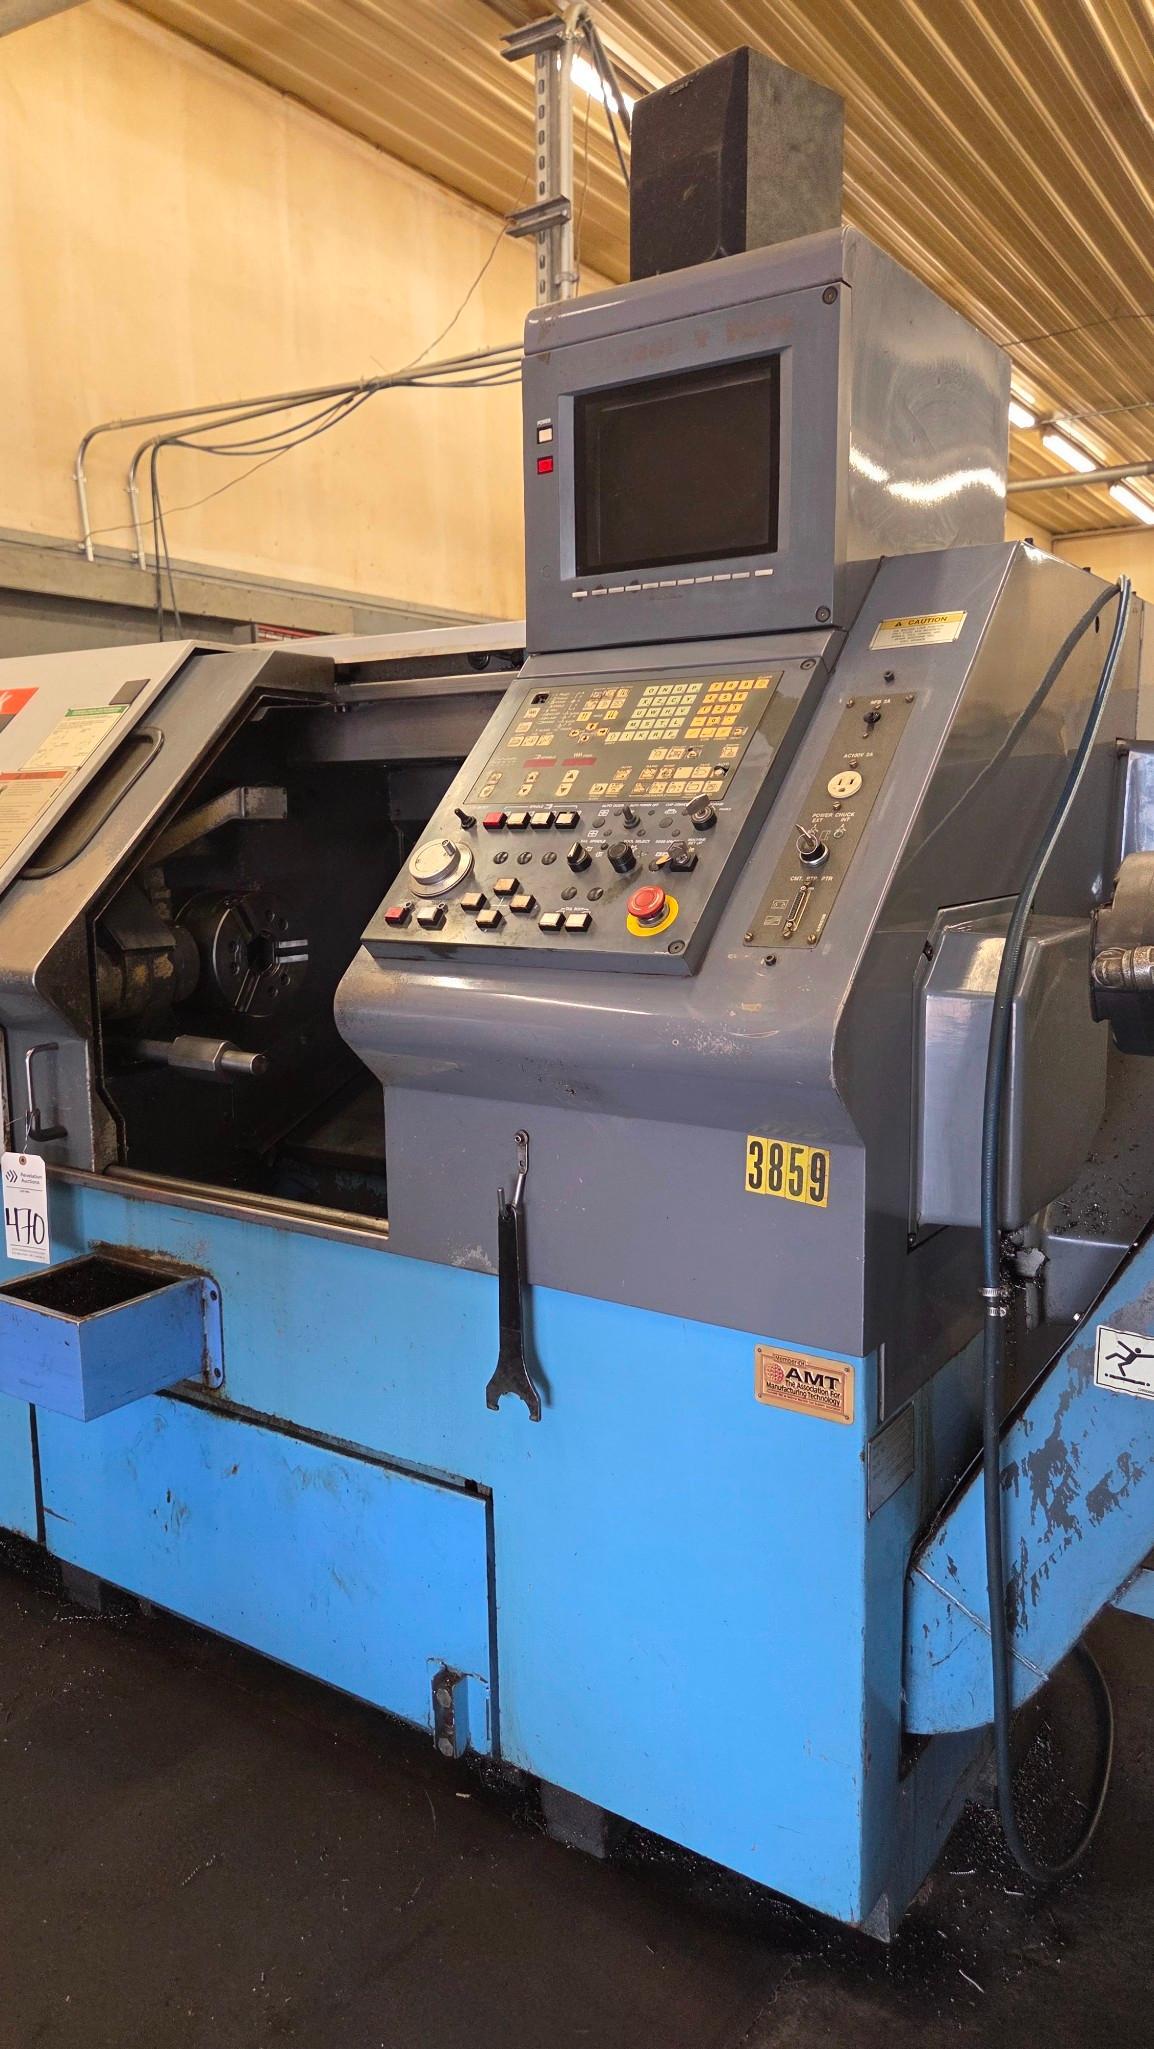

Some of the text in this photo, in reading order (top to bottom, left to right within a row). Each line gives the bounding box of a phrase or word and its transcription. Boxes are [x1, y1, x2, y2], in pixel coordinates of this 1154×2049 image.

[908, 616, 948, 625] CAUTION
[748, 1140, 827, 1203] 3859
[5, 1207, 45, 1245] 470
[785, 1367, 841, 1390] AMT
[785, 1379, 796, 1388] The
[797, 1381, 829, 1396] Association
[766, 1381, 807, 1400] Manufacturing
[808, 1392, 841, 1407] Technology
